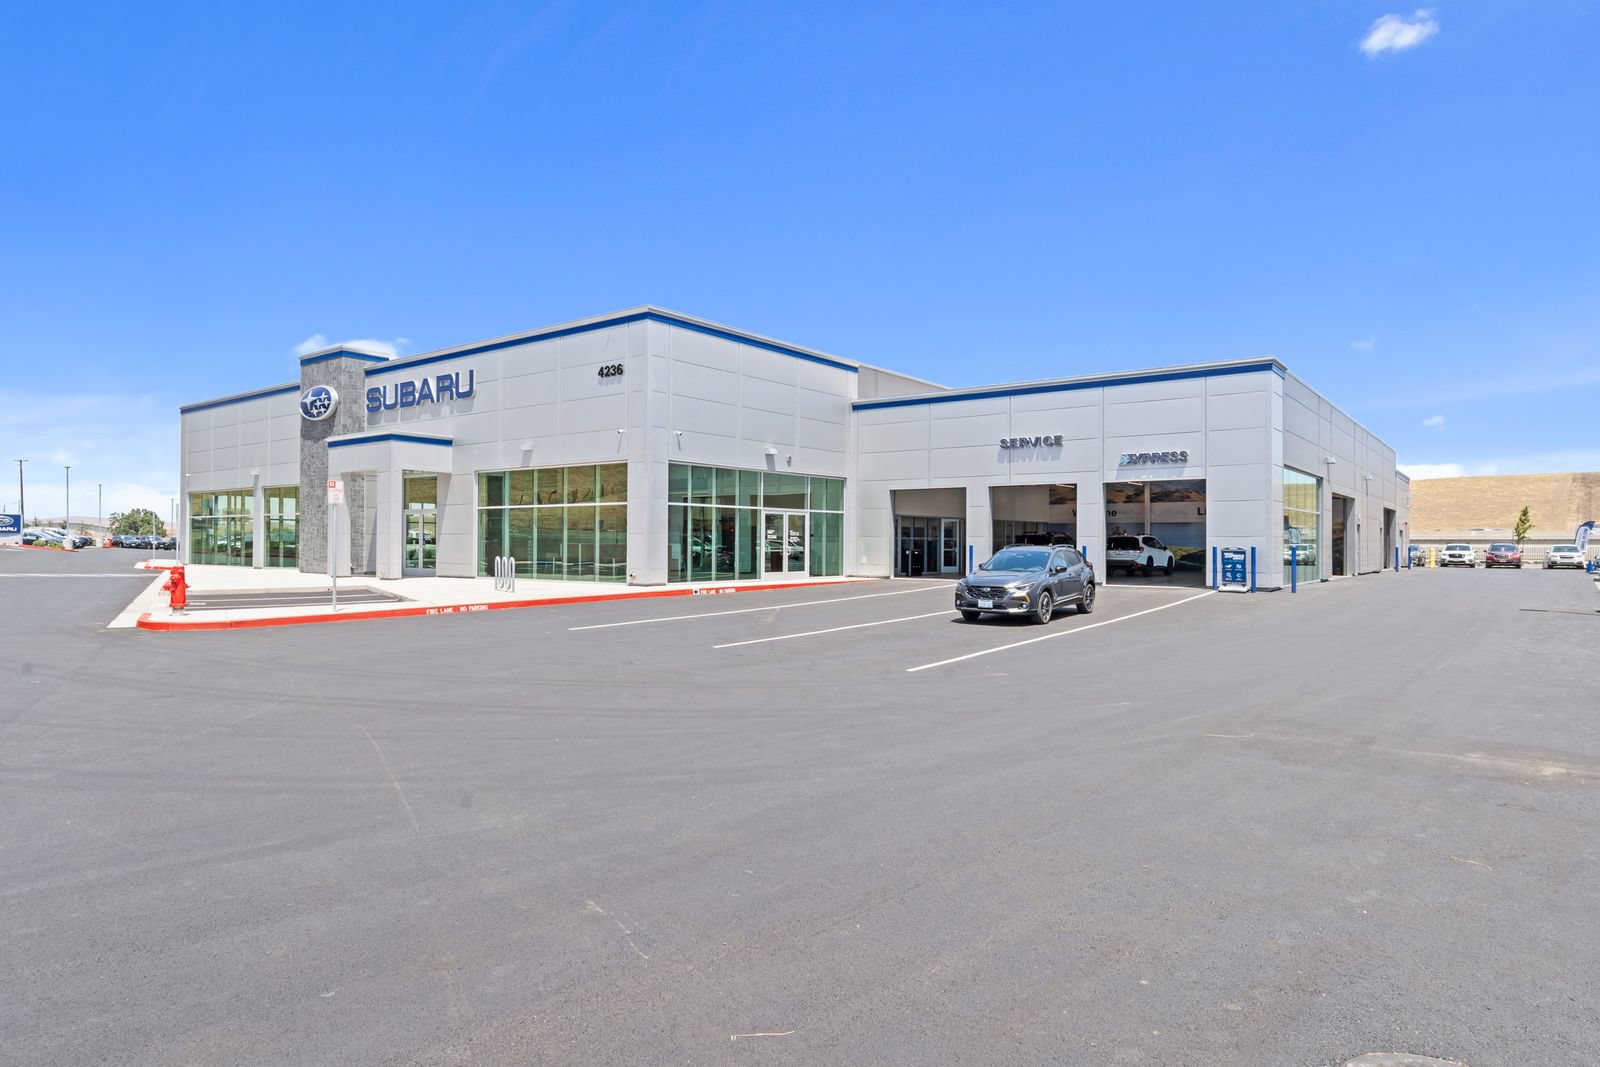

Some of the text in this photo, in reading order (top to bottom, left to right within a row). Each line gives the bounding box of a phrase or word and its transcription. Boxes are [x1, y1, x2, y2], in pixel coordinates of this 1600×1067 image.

[598, 363, 624, 378] 4236
[366, 369, 474, 413] SUBARU
[1000, 435, 1063, 449] SERVICE
[1120, 451, 1188, 466] EXPRESS
